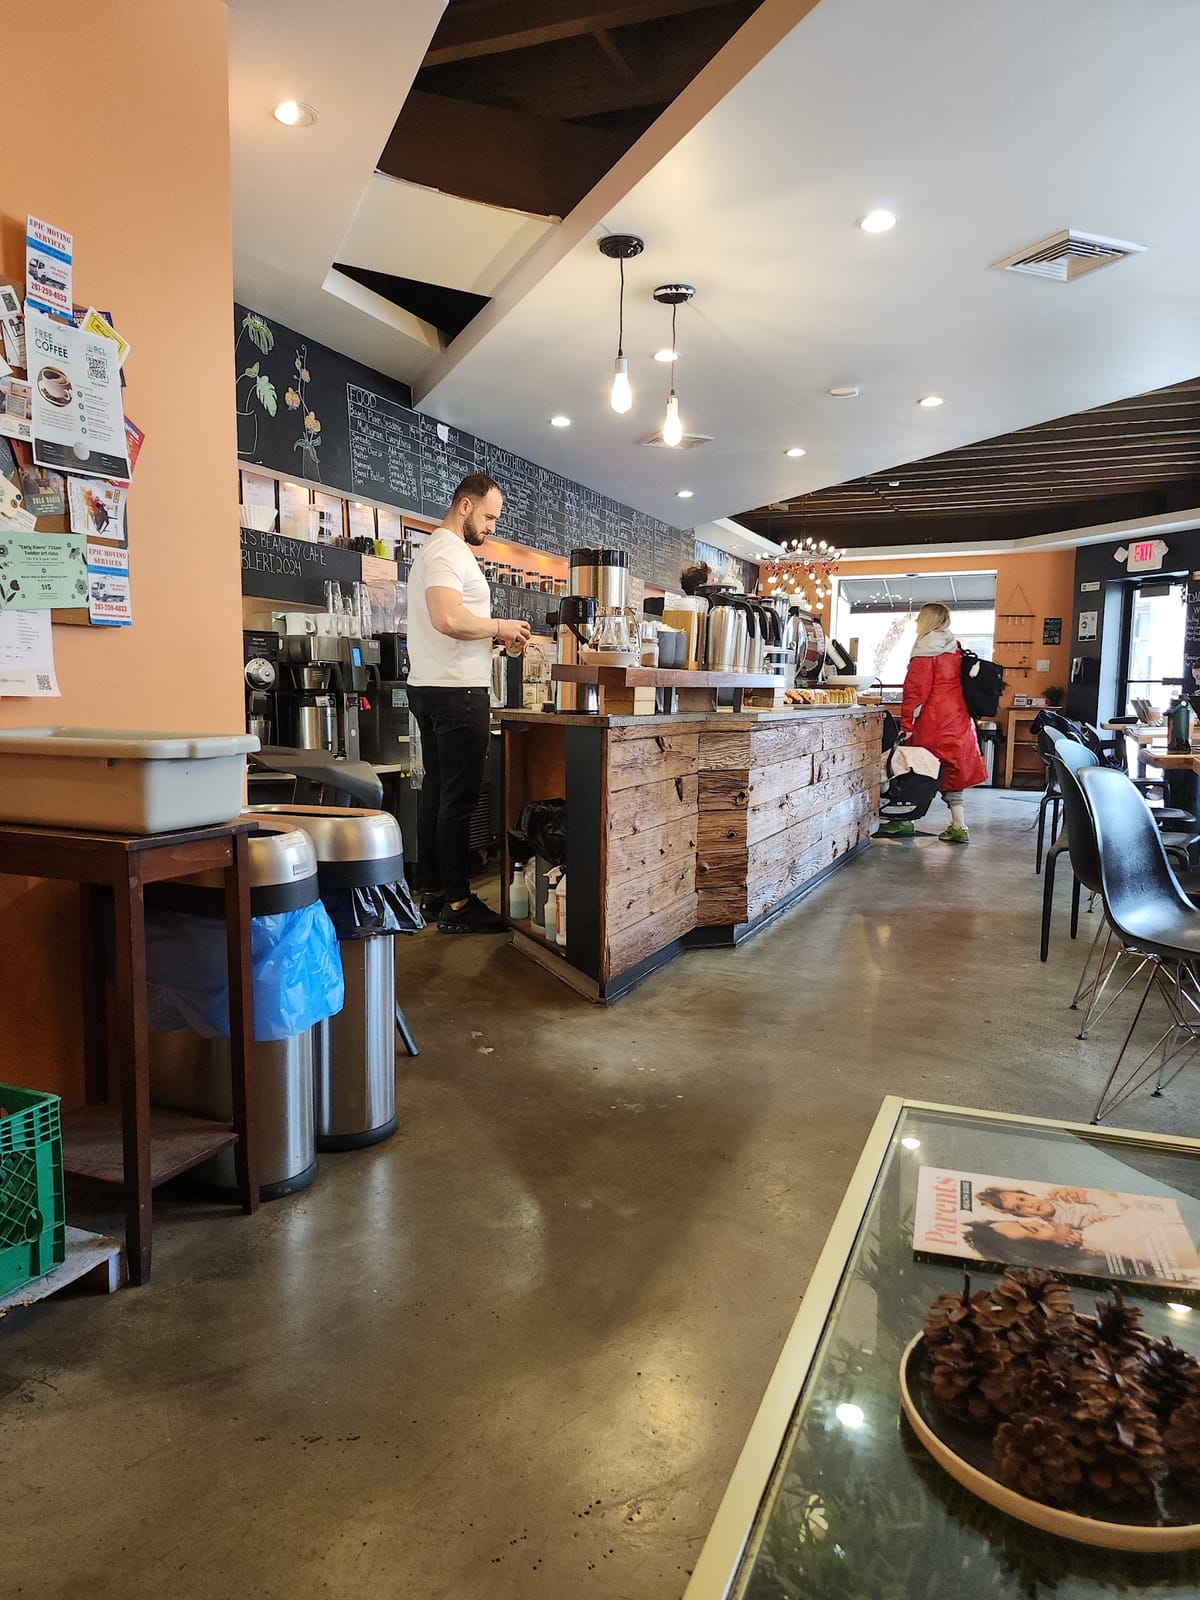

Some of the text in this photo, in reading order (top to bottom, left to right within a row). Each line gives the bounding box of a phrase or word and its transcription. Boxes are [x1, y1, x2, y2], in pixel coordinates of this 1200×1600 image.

[30, 218, 71, 244] EPIC MOVING
[34, 231, 66, 251] SERVICES
[35, 328, 53, 343] FREE
[35, 338, 69, 359] COFFEE
[350, 386, 377, 408] FOOD
[89, 548, 126, 559] EPIC MOVING
[261, 533, 302, 559] BEANERY
[303, 545, 327, 566] CAFE
[1134, 544, 1153, 562] EXIT
[94, 558, 122, 566] SERVICES
[924, 1176, 957, 1246] Parents
